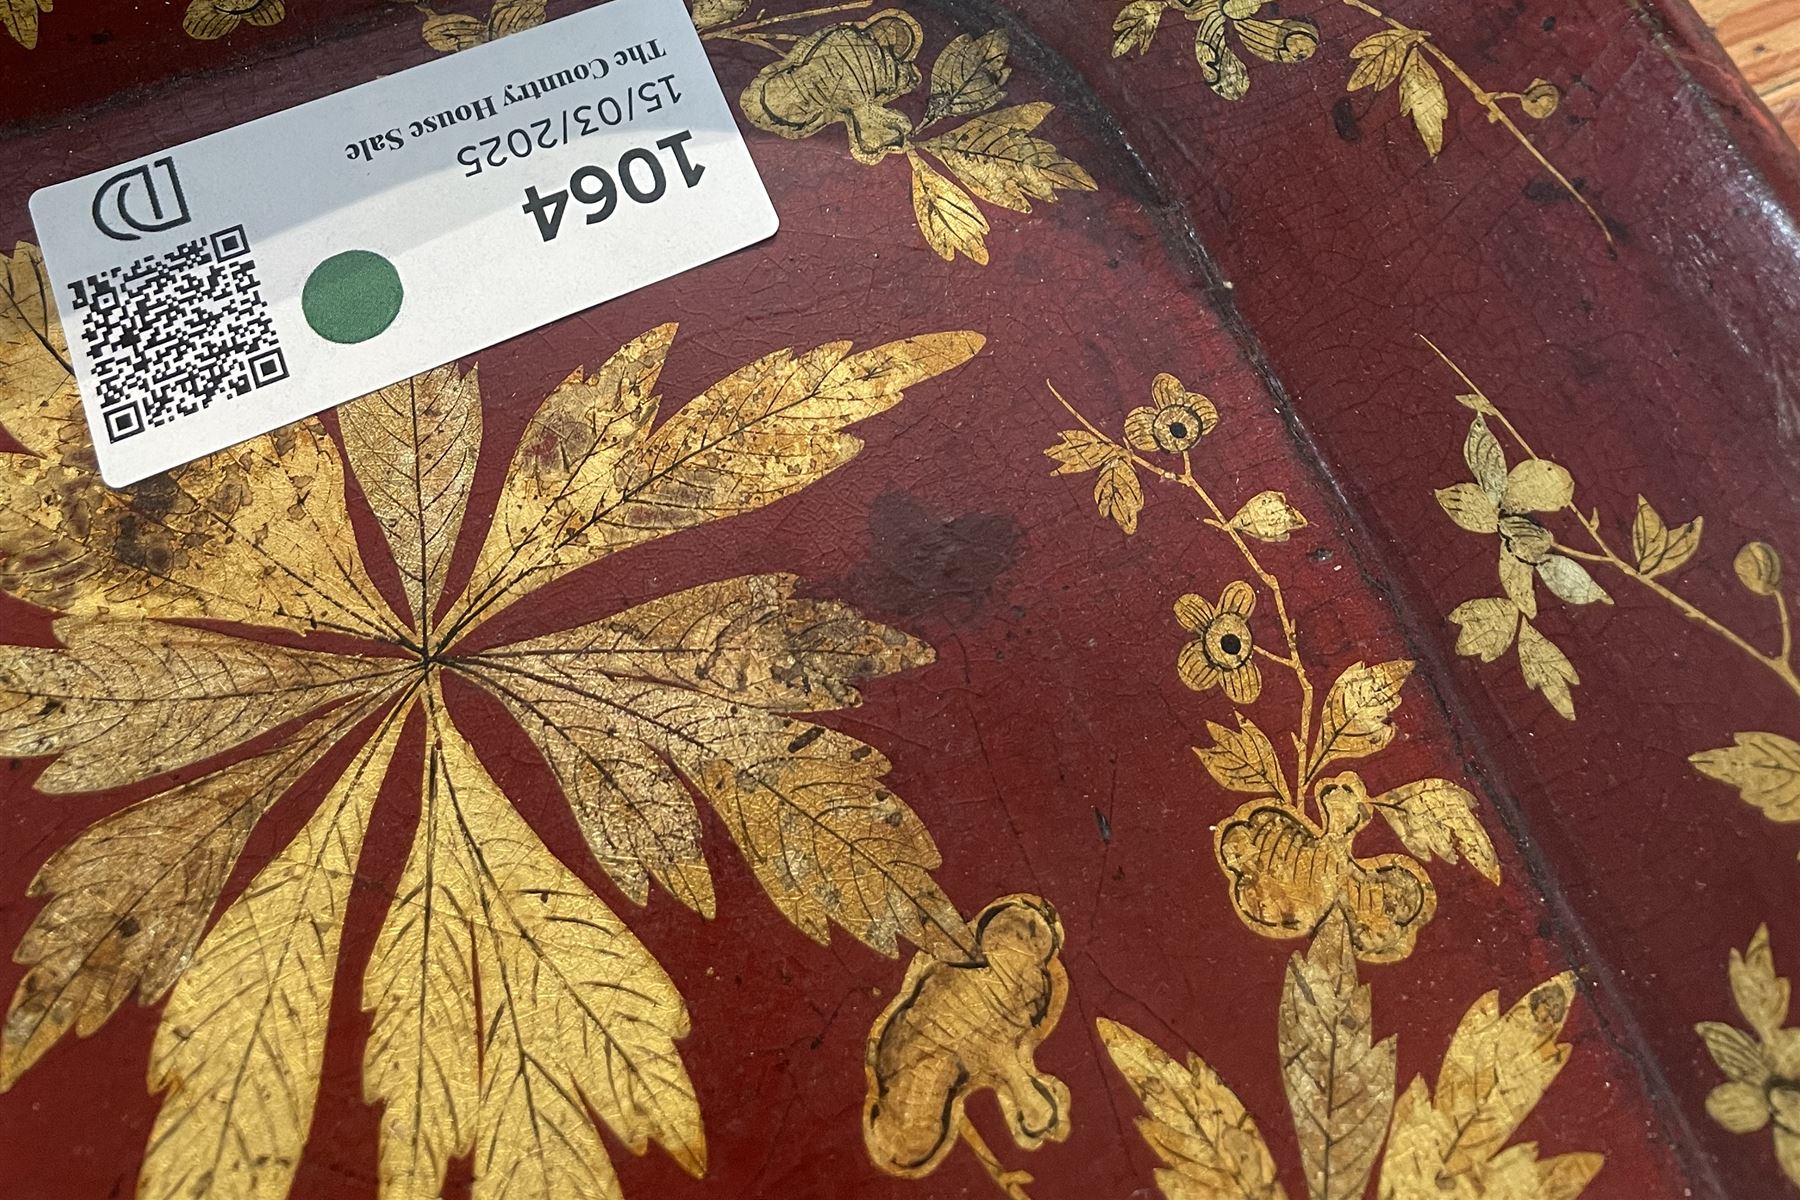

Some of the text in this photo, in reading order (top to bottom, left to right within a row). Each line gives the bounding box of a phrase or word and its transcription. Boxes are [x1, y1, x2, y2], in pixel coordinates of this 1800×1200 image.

[345, 38, 667, 162] The Country House Sale
[456, 73, 682, 178] 15/03/2025
[522, 129, 705, 243] 1064
